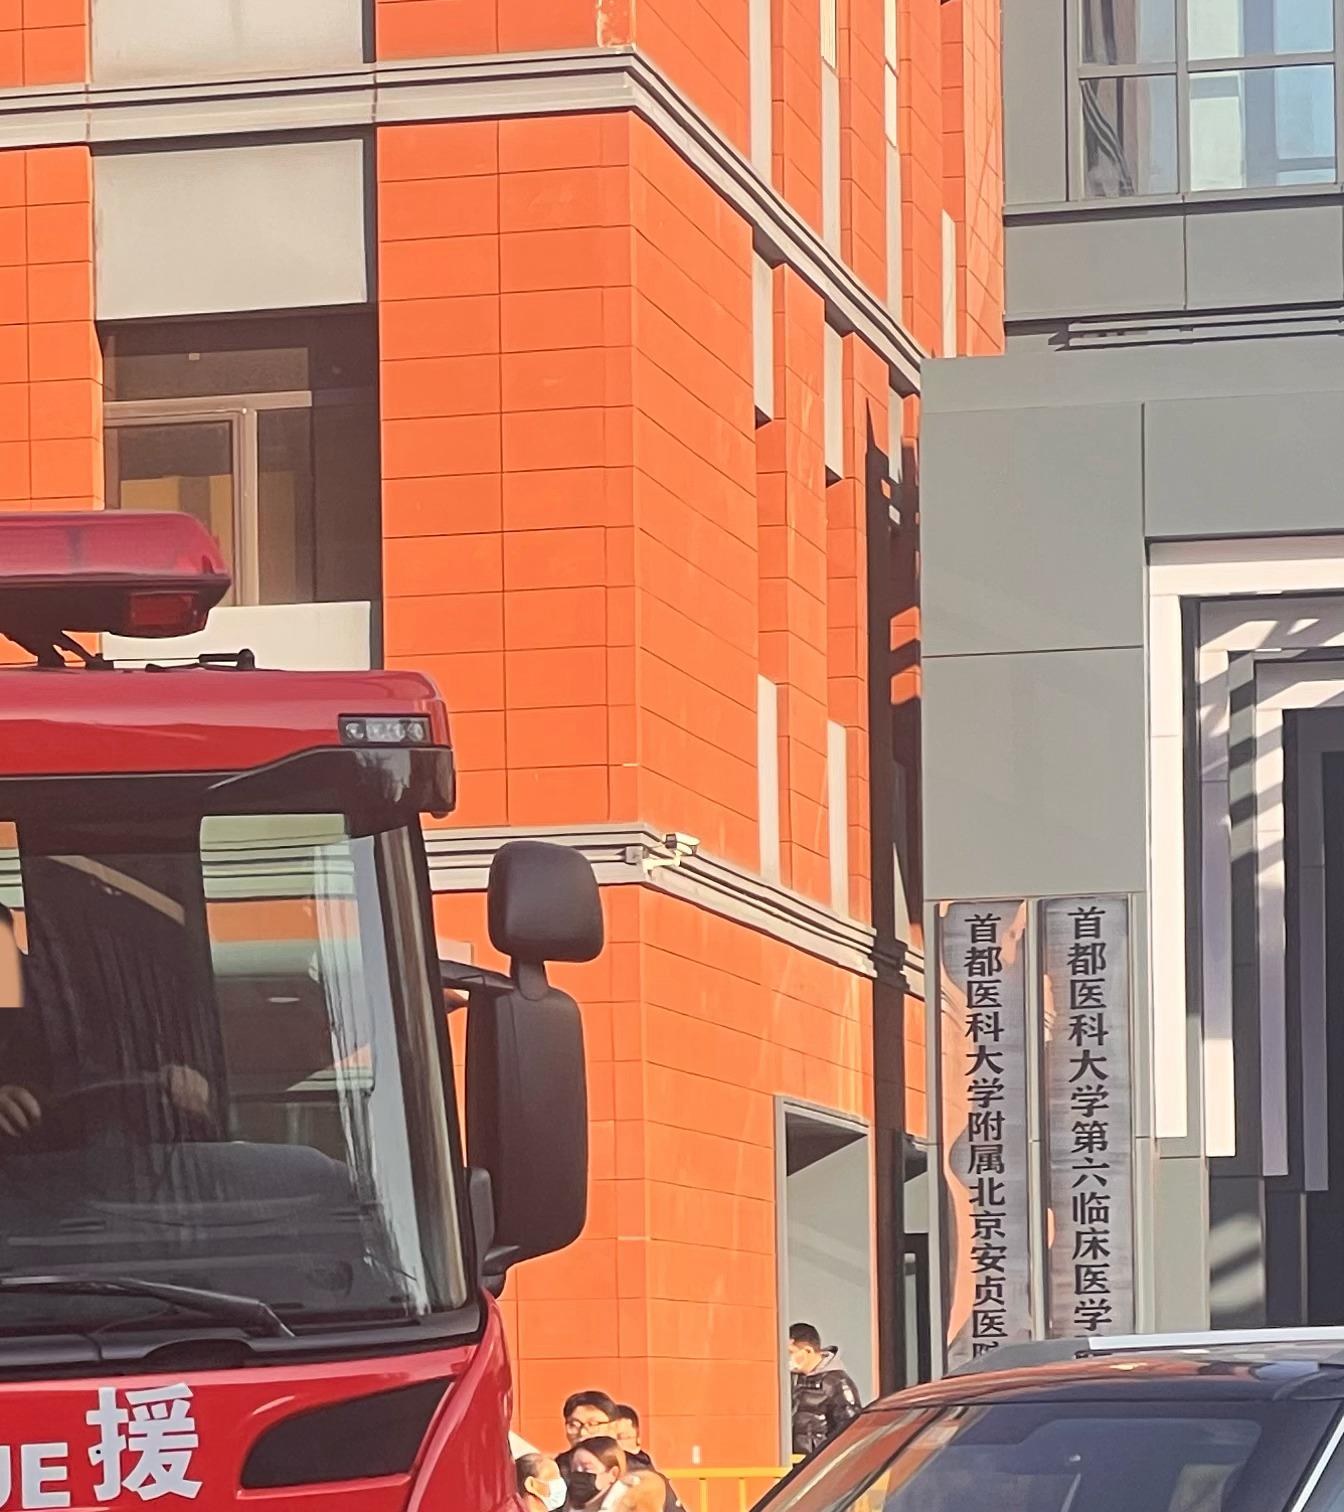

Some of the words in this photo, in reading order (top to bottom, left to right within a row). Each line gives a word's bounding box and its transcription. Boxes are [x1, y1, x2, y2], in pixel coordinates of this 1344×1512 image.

[1067, 905, 1113, 1360] 首都医科大学第六临床医学
[86, 1382, 203, 1502] 援
